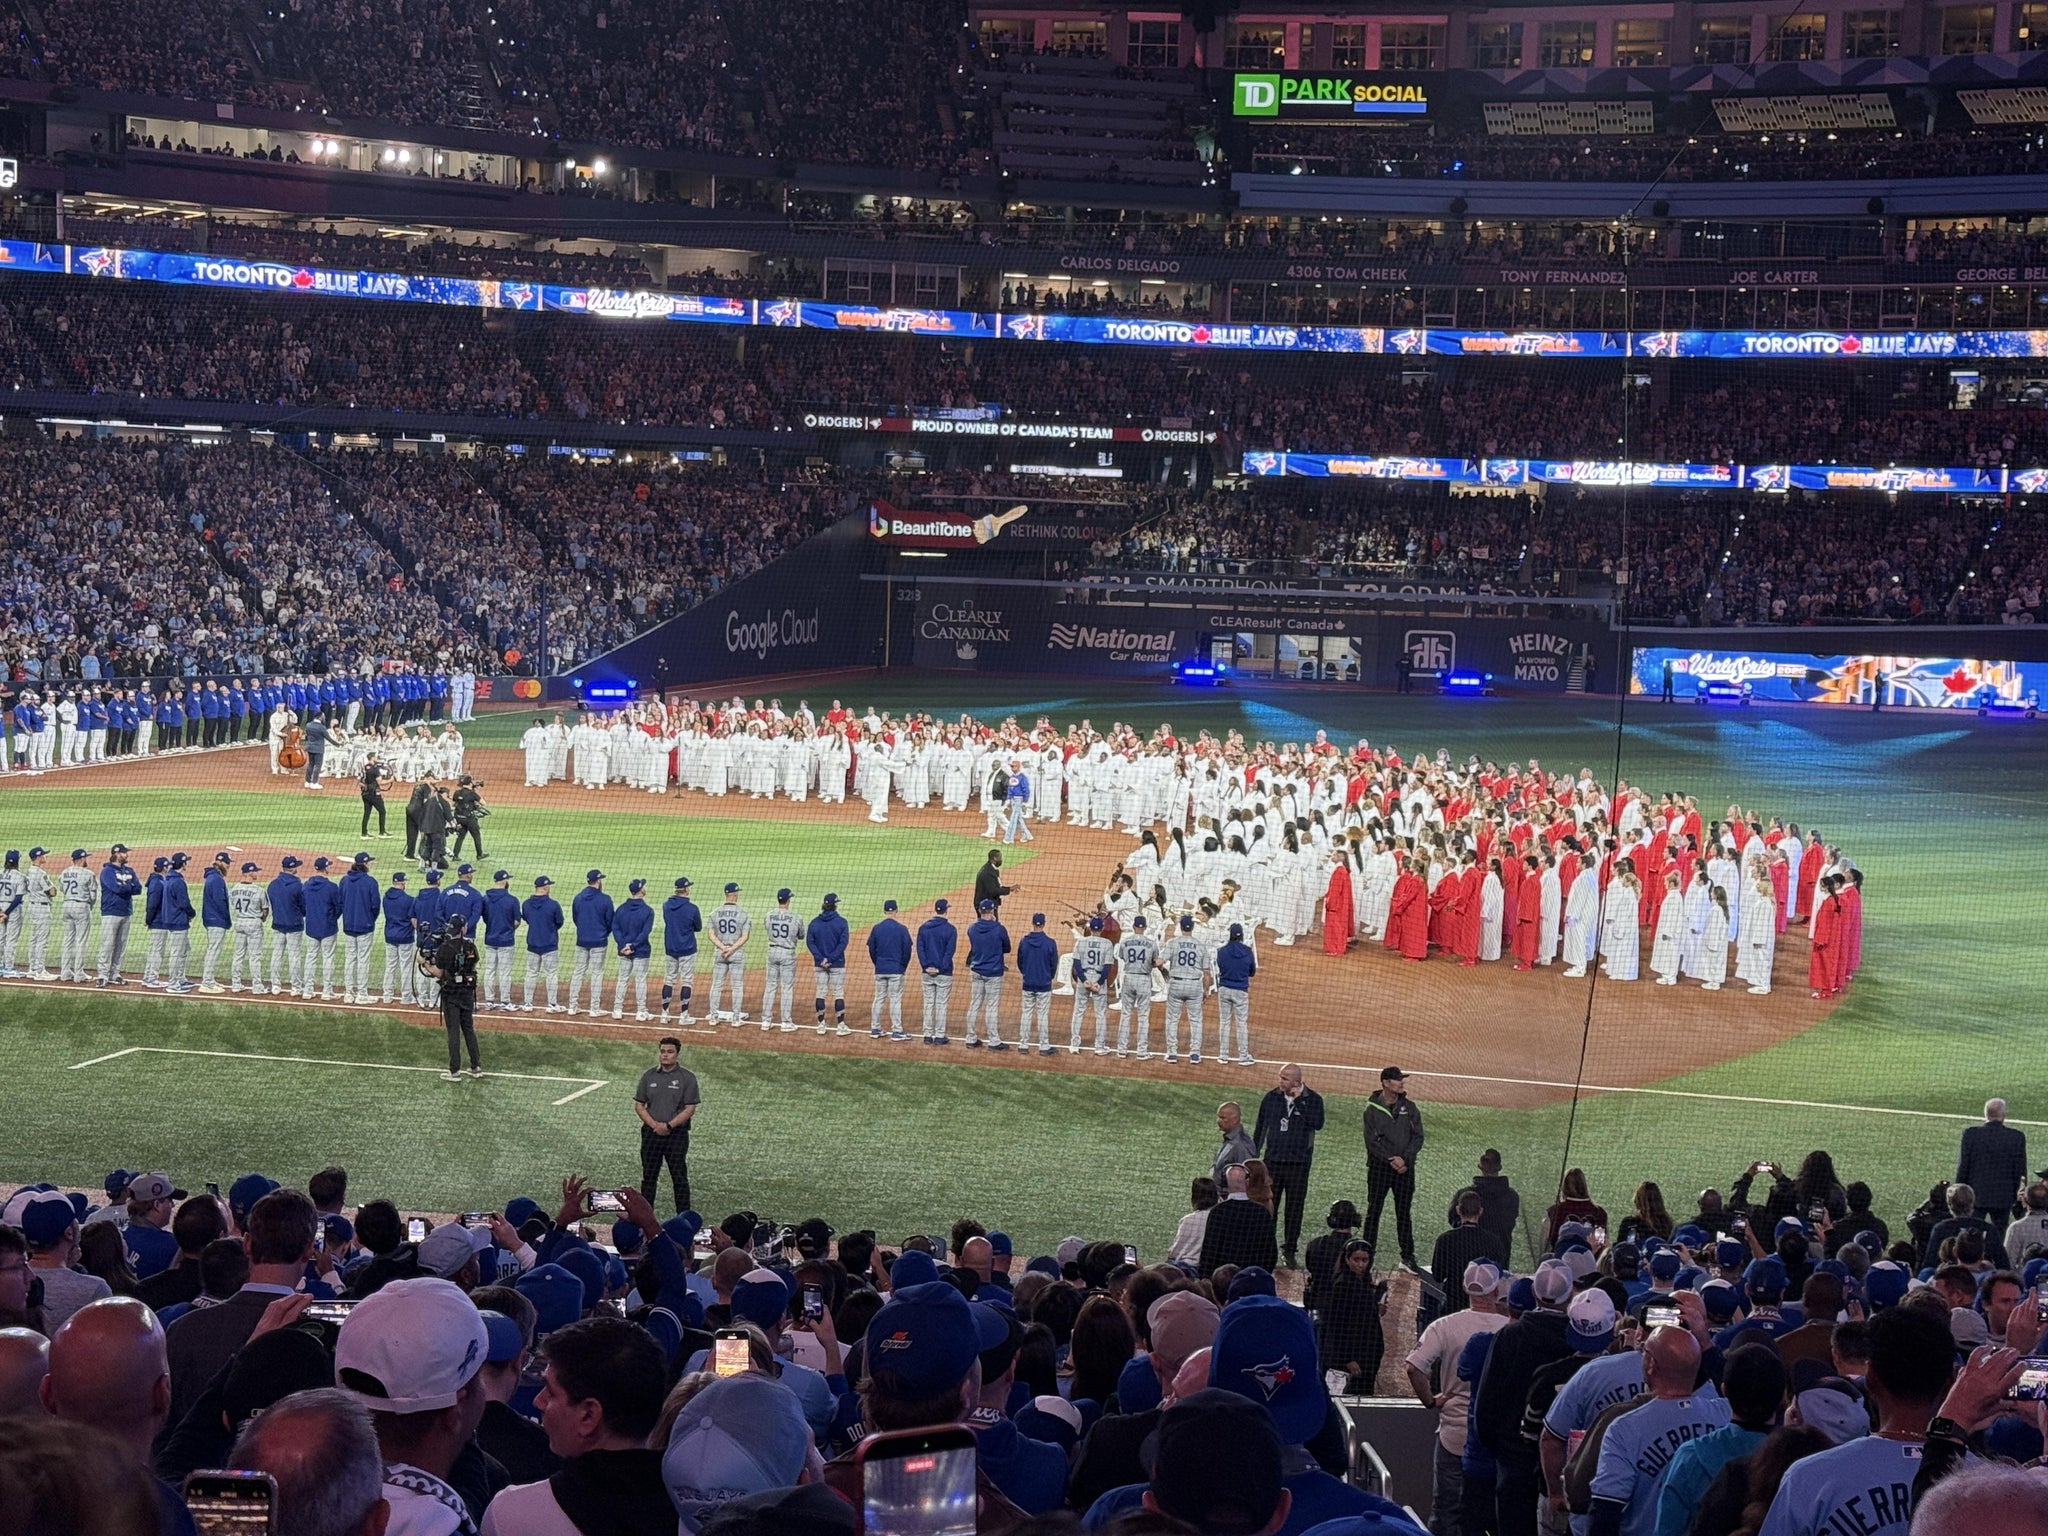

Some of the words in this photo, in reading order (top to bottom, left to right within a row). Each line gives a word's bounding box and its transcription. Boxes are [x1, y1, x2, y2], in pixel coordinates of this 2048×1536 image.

[1239, 81, 1275, 107] TD
[1282, 79, 1352, 99] PARK
[1354, 85, 1427, 102] SOCIAL
[1060, 256, 1112, 270] CARLOS
[1117, 259, 1180, 273] DELGADO
[194, 262, 292, 287] TORONTO
[314, 272, 358, 293] BLUE
[362, 276, 409, 296] JAYS
[1286, 265, 1321, 279] 4306
[1326, 267, 1358, 280] TOM
[1362, 268, 1408, 281] CHEEK
[1501, 270, 1539, 282] TONY
[1545, 271, 1626, 284] FERNANDEZ
[1729, 271, 1757, 283] JOE
[1764, 271, 1818, 283] CARTER
[1956, 268, 2017, 281] GEORGE
[1105, 323, 1192, 343] TORONTO
[1211, 328, 1250, 345] BLUE
[1254, 330, 1298, 347] JAYS
[1744, 336, 1839, 353] TORONTO
[1862, 336, 1906, 354] BLUE
[1909, 336, 1957, 354] JAYS
[818, 416, 862, 428] ROGERS
[912, 420, 954, 433] PROUD
[955, 422, 999, 435] OWNER
[1001, 424, 1018, 436] OF
[1018, 425, 1078, 438] CANADA'S
[1080, 427, 1113, 440] TEAM
[1155, 432, 1198, 442] ROGERS
[892, 519, 972, 538] BeautiTone
[1010, 524, 1058, 538] RETHINK
[1210, 616, 1282, 629] CLEAResult
[1287, 618, 1334, 631] Canada
[726, 608, 778, 660] Google
[781, 607, 818, 646] Cloud
[1077, 626, 1176, 651] National
[1508, 633, 1569, 656] HEINZ
[1110, 650, 1130, 661] Car
[1132, 652, 1170, 663] Rental
[1514, 665, 1559, 681] MAYO
[1689, 653, 1738, 676] World
[1728, 656, 1776, 683] Series
[63, 880, 78, 895] 72
[235, 898, 251, 913] 47
[718, 918, 737, 934] 86
[771, 923, 789, 939] 59
[1087, 949, 1101, 966] 91
[1127, 948, 1147, 964] 84
[1178, 950, 1197, 967] 88
